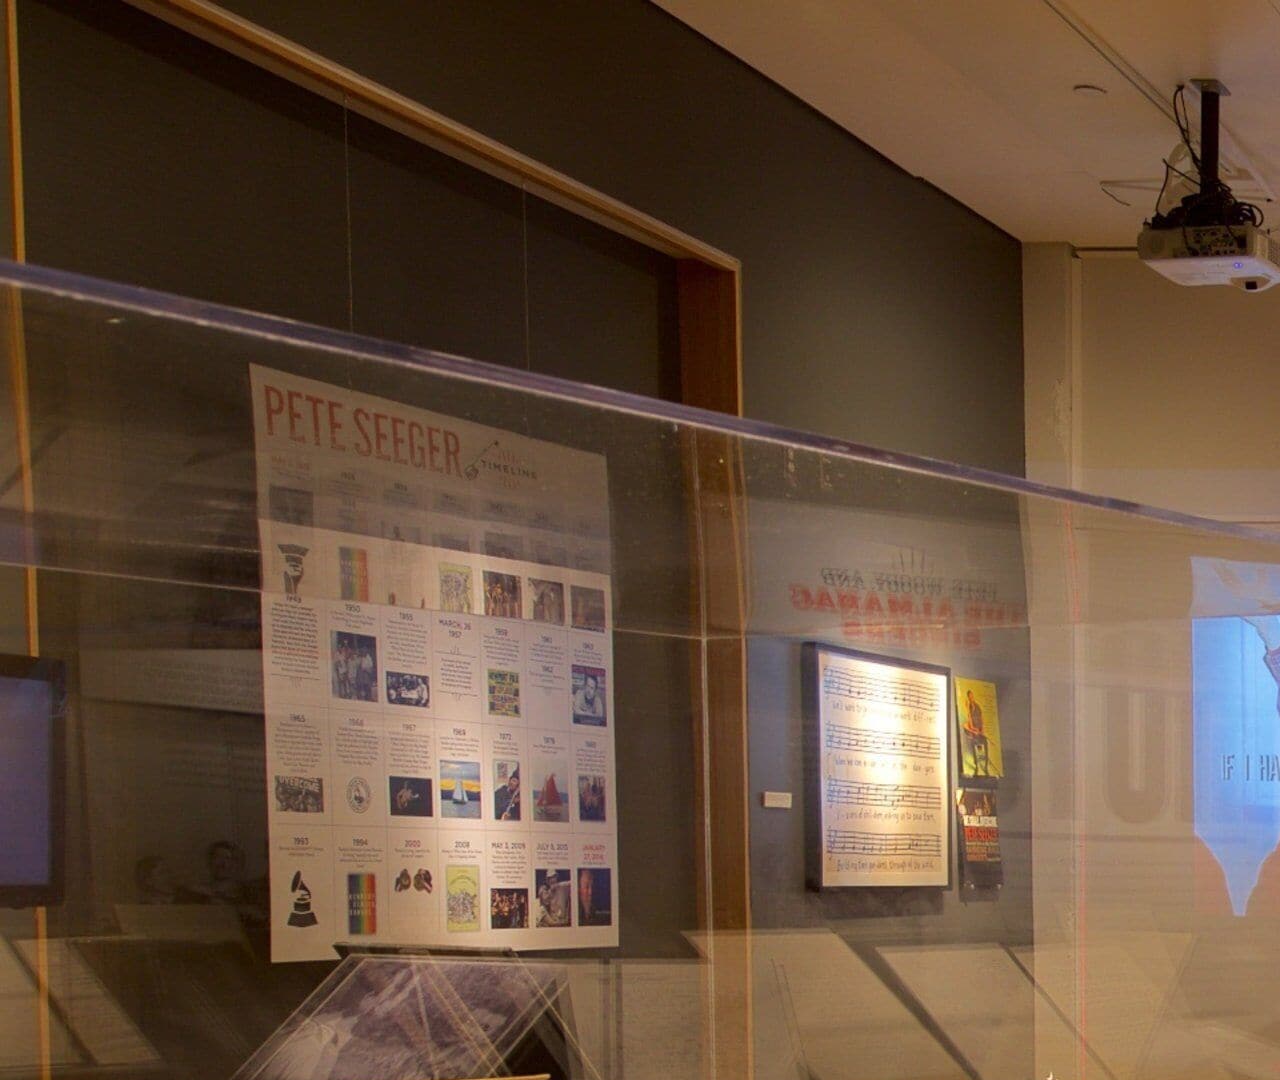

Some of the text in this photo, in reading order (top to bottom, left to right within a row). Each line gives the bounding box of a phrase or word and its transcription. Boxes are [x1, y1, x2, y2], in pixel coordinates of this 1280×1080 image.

[263, 384, 464, 479] PETE SEEGER
[480, 458, 538, 480] TIMELINE
[1221, 754, 1236, 782] IF
